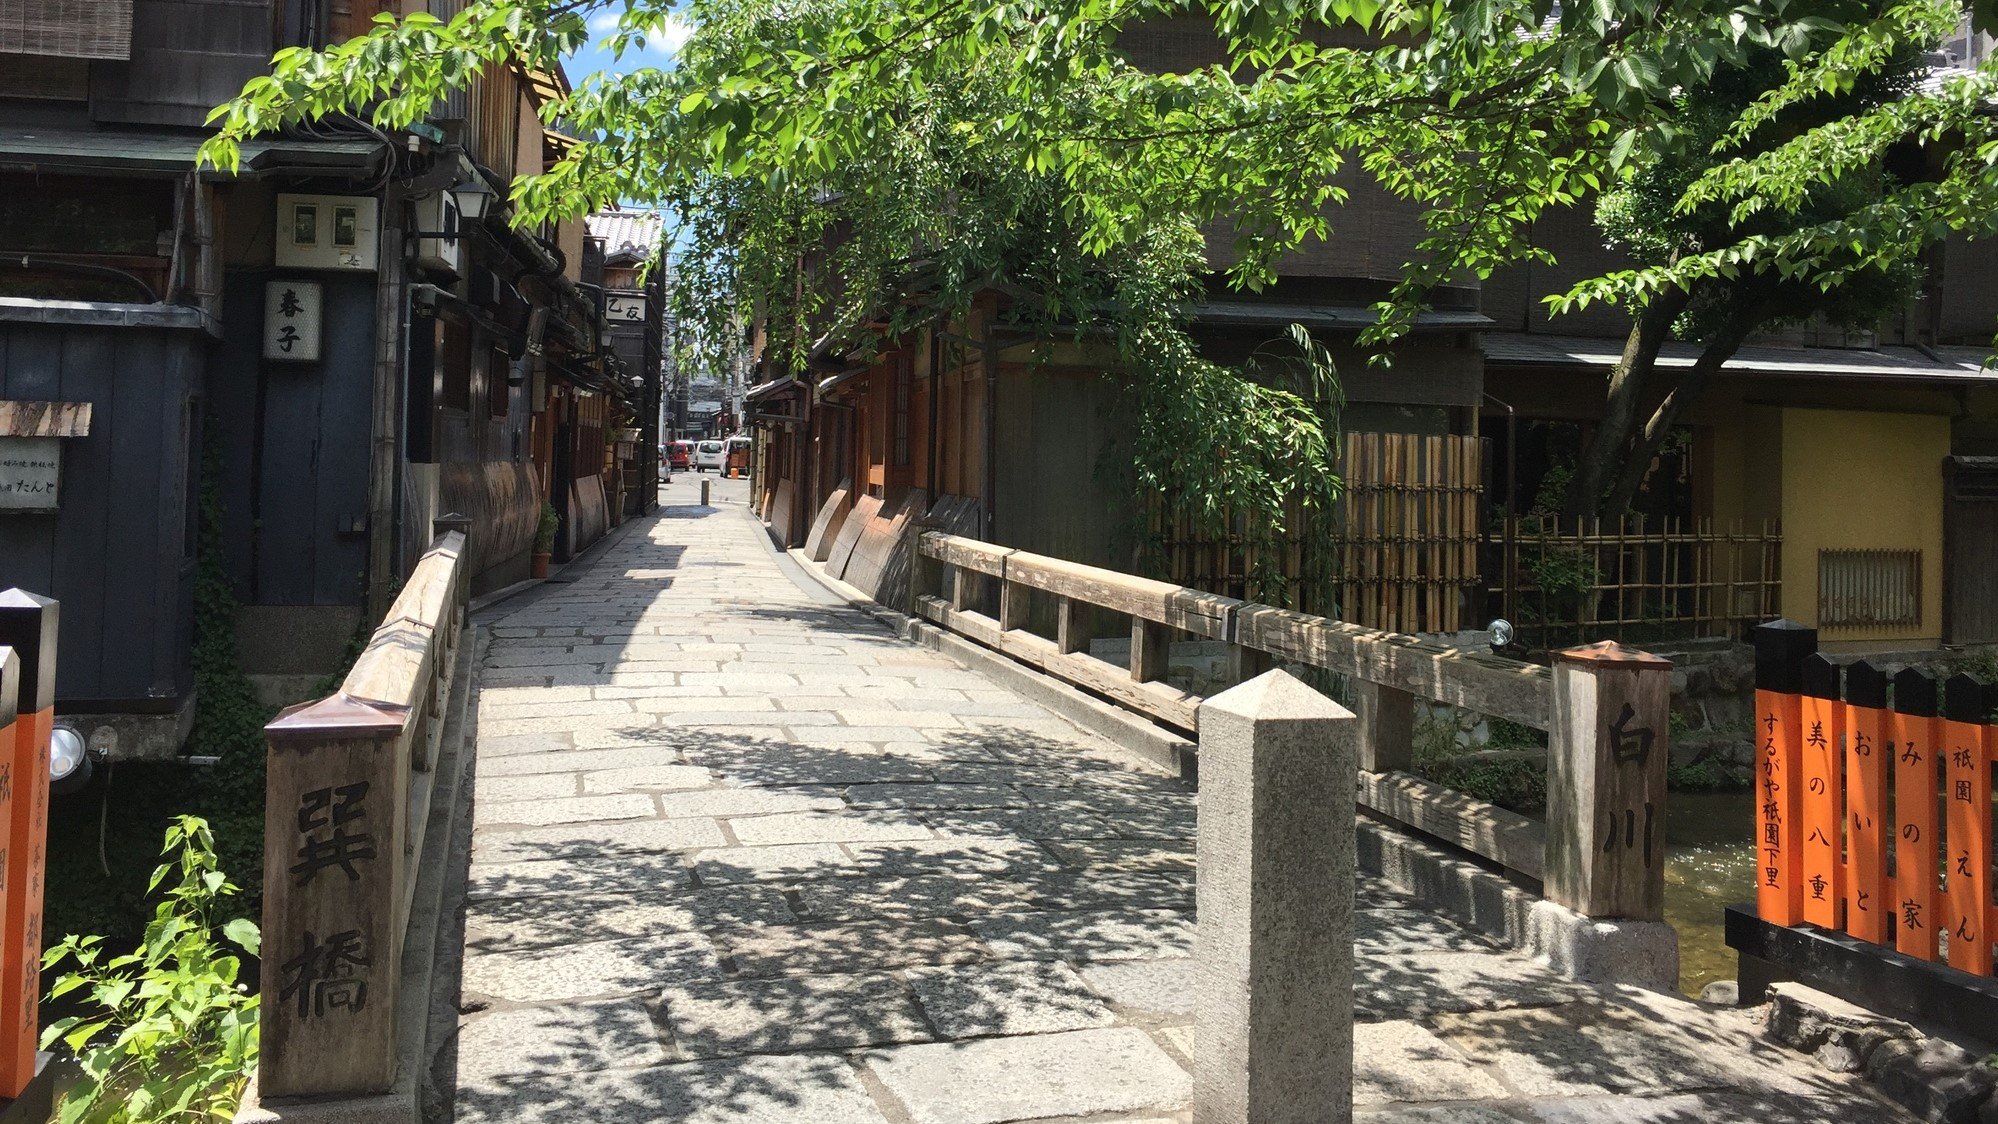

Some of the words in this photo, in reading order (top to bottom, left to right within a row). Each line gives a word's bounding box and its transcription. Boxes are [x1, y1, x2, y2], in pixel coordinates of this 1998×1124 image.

[277, 288, 305, 353] 春子
[608, 297, 643, 321] 乙友
[1603, 702, 1655, 869] 白川
[1763, 712, 1782, 890] するがや祇園下里
[1806, 720, 1831, 902] 美の八重
[1854, 730, 1872, 912] おいと
[1901, 741, 1924, 931] みの家
[279, 780, 378, 1020] 巽橋
